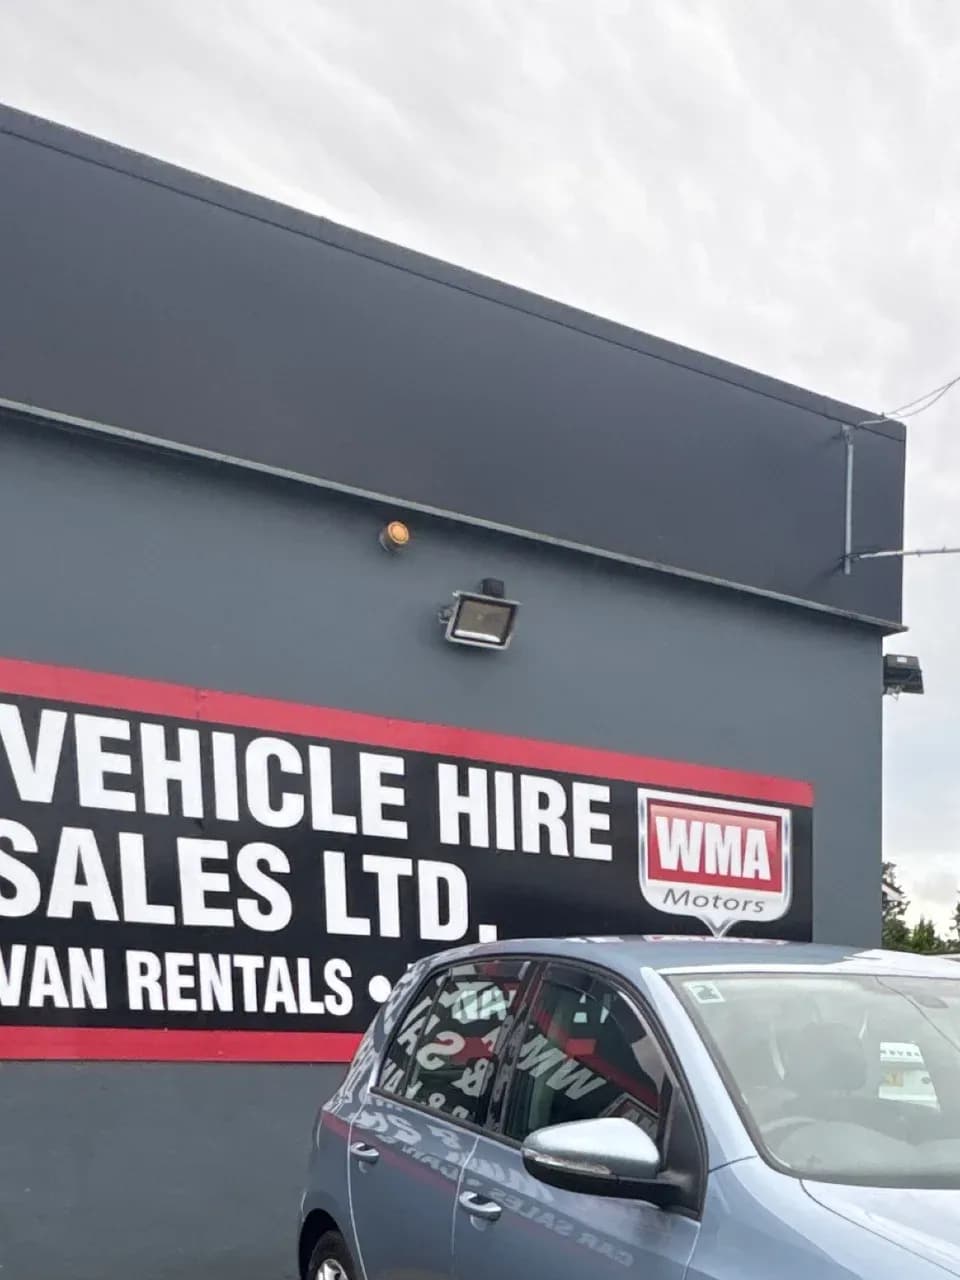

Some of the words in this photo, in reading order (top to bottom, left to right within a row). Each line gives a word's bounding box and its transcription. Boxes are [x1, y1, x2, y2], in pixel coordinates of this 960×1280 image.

[0, 702, 408, 840] VEHICLE
[437, 762, 613, 861] HIRE
[0, 817, 293, 932] SALES
[323, 850, 497, 943] LTD.
[655, 815, 772, 881] WMA
[663, 887, 765, 913] Motors
[0, 943, 108, 1010] VAN
[124, 949, 354, 1017] RENTALS
